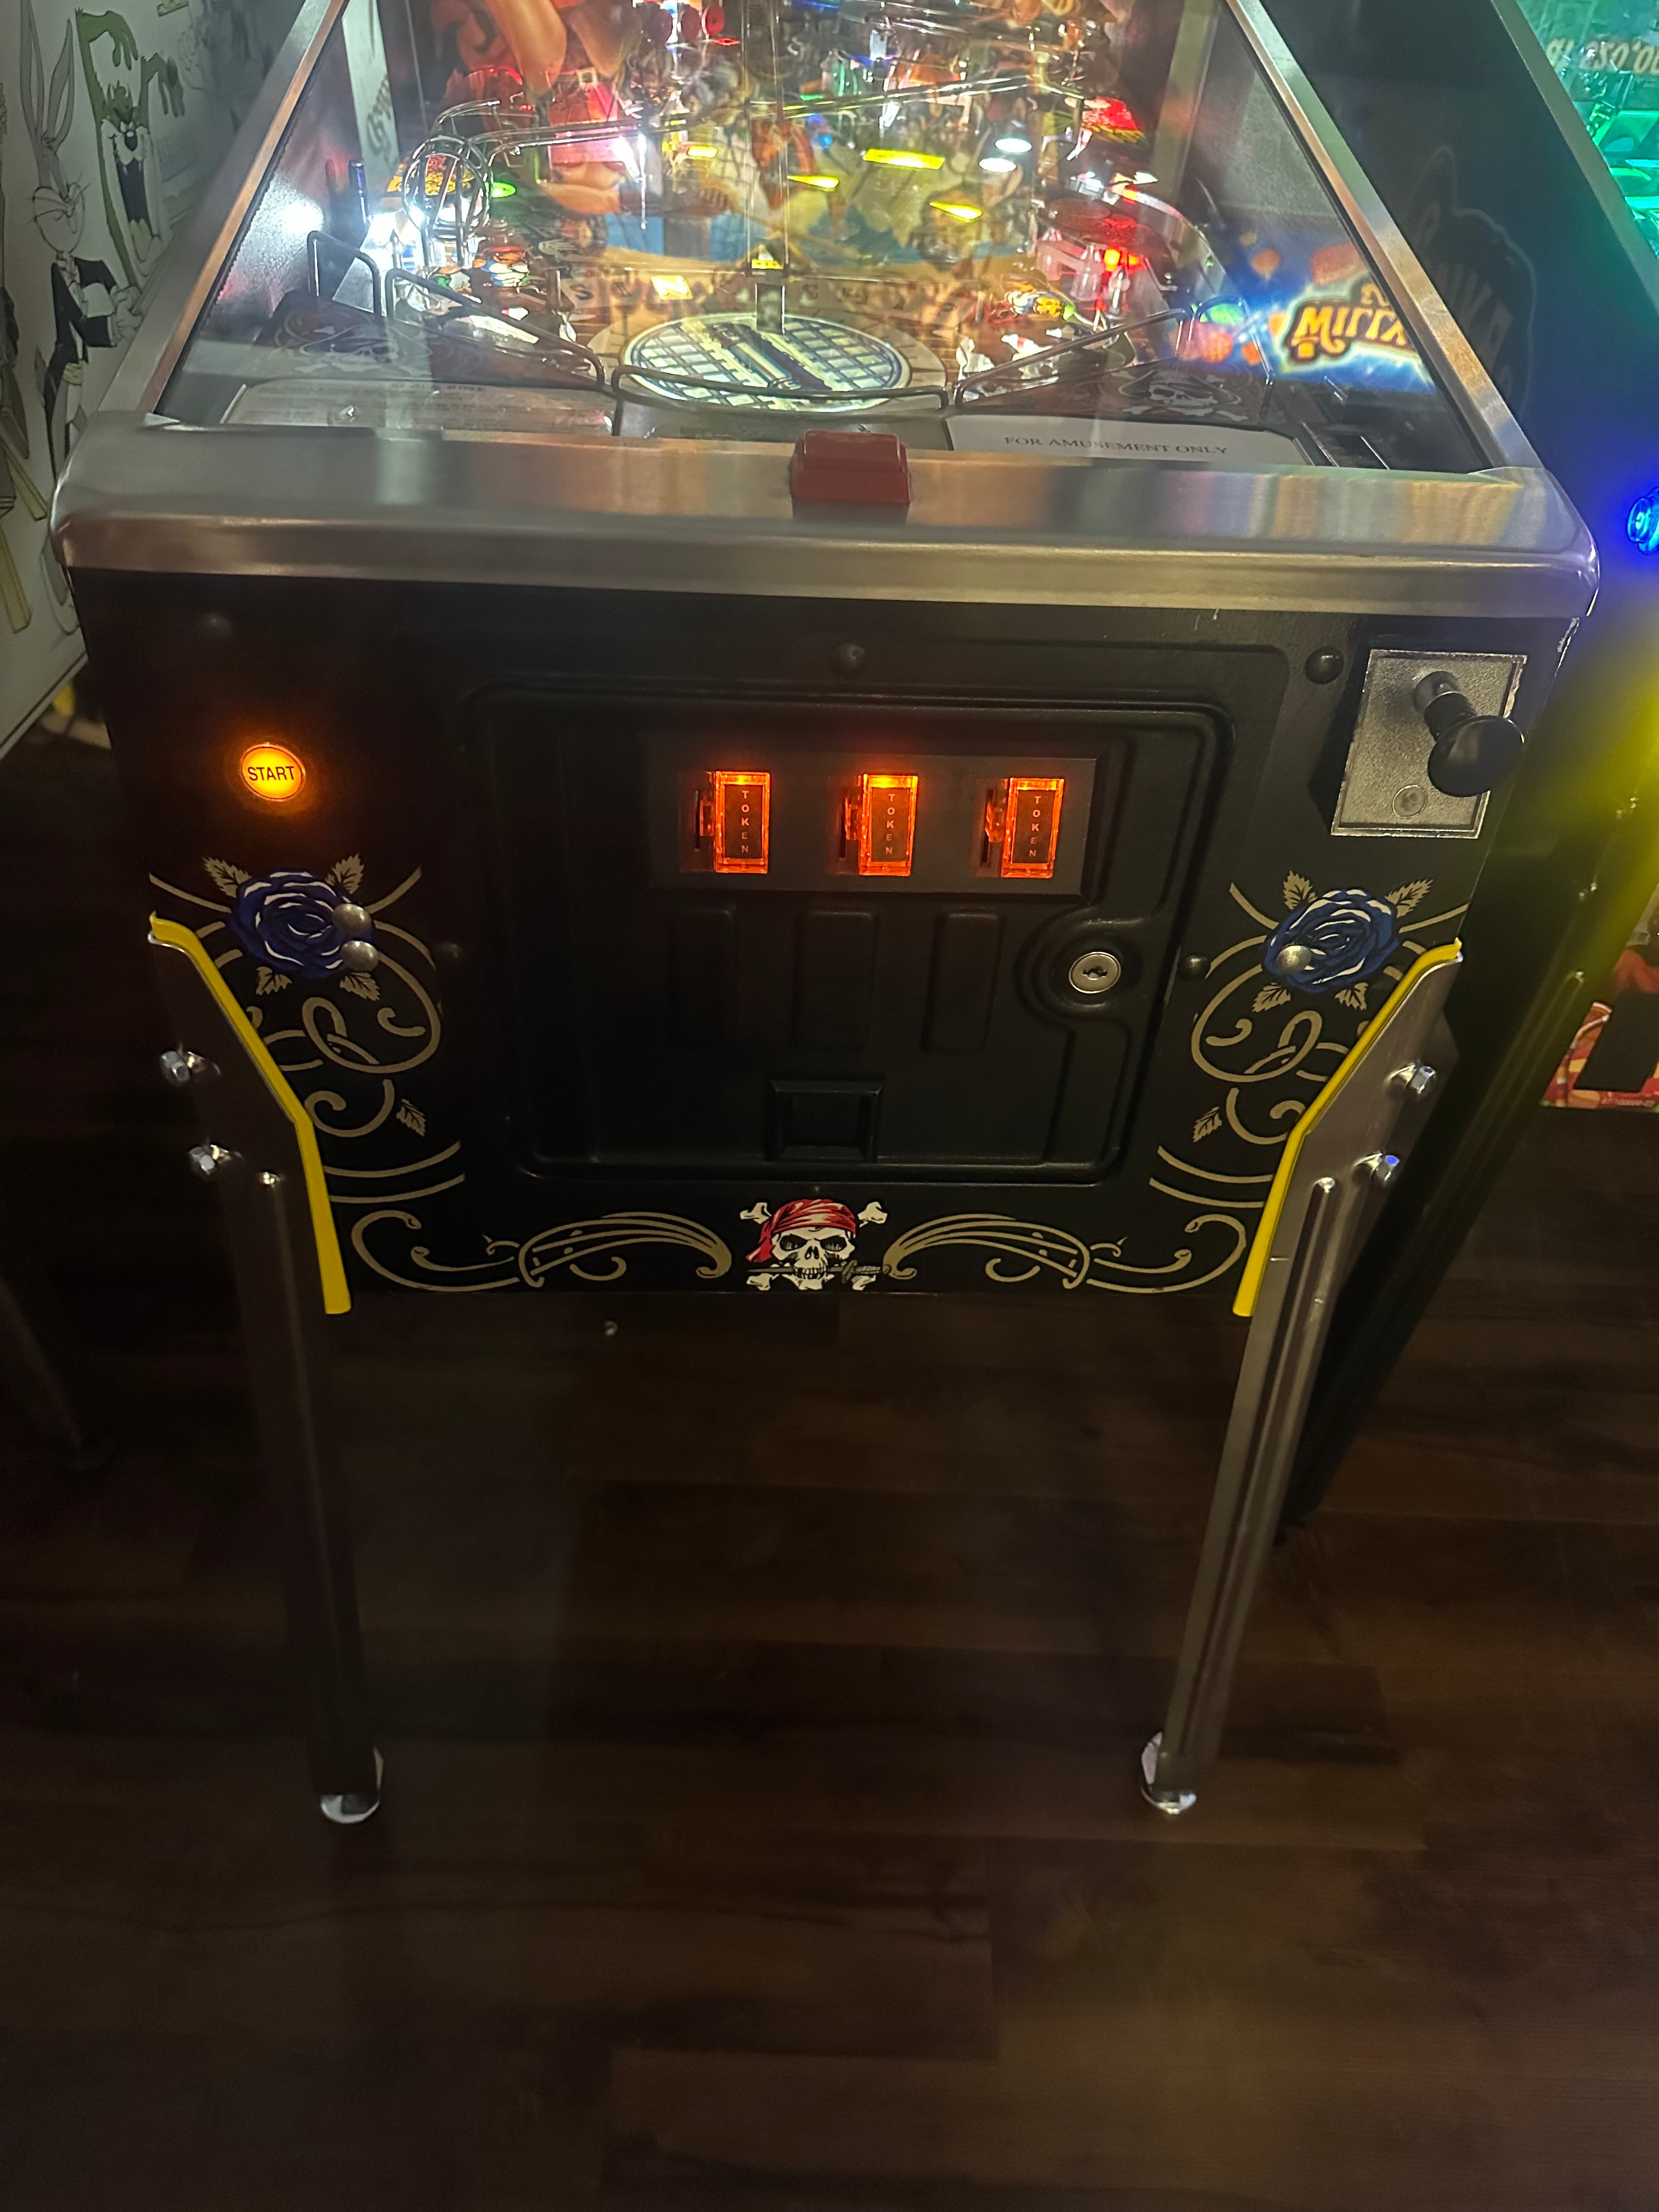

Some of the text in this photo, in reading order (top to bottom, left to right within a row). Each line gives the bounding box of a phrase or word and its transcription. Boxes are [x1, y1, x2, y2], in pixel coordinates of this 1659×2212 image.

[1005, 437, 1229, 455] FOR AMUSEMENT ONLY
[247, 766, 294, 781] START
[741, 791, 749, 853] TOKEN
[885, 793, 895, 854] TOKEN
[1029, 796, 1041, 857] TOKEN
